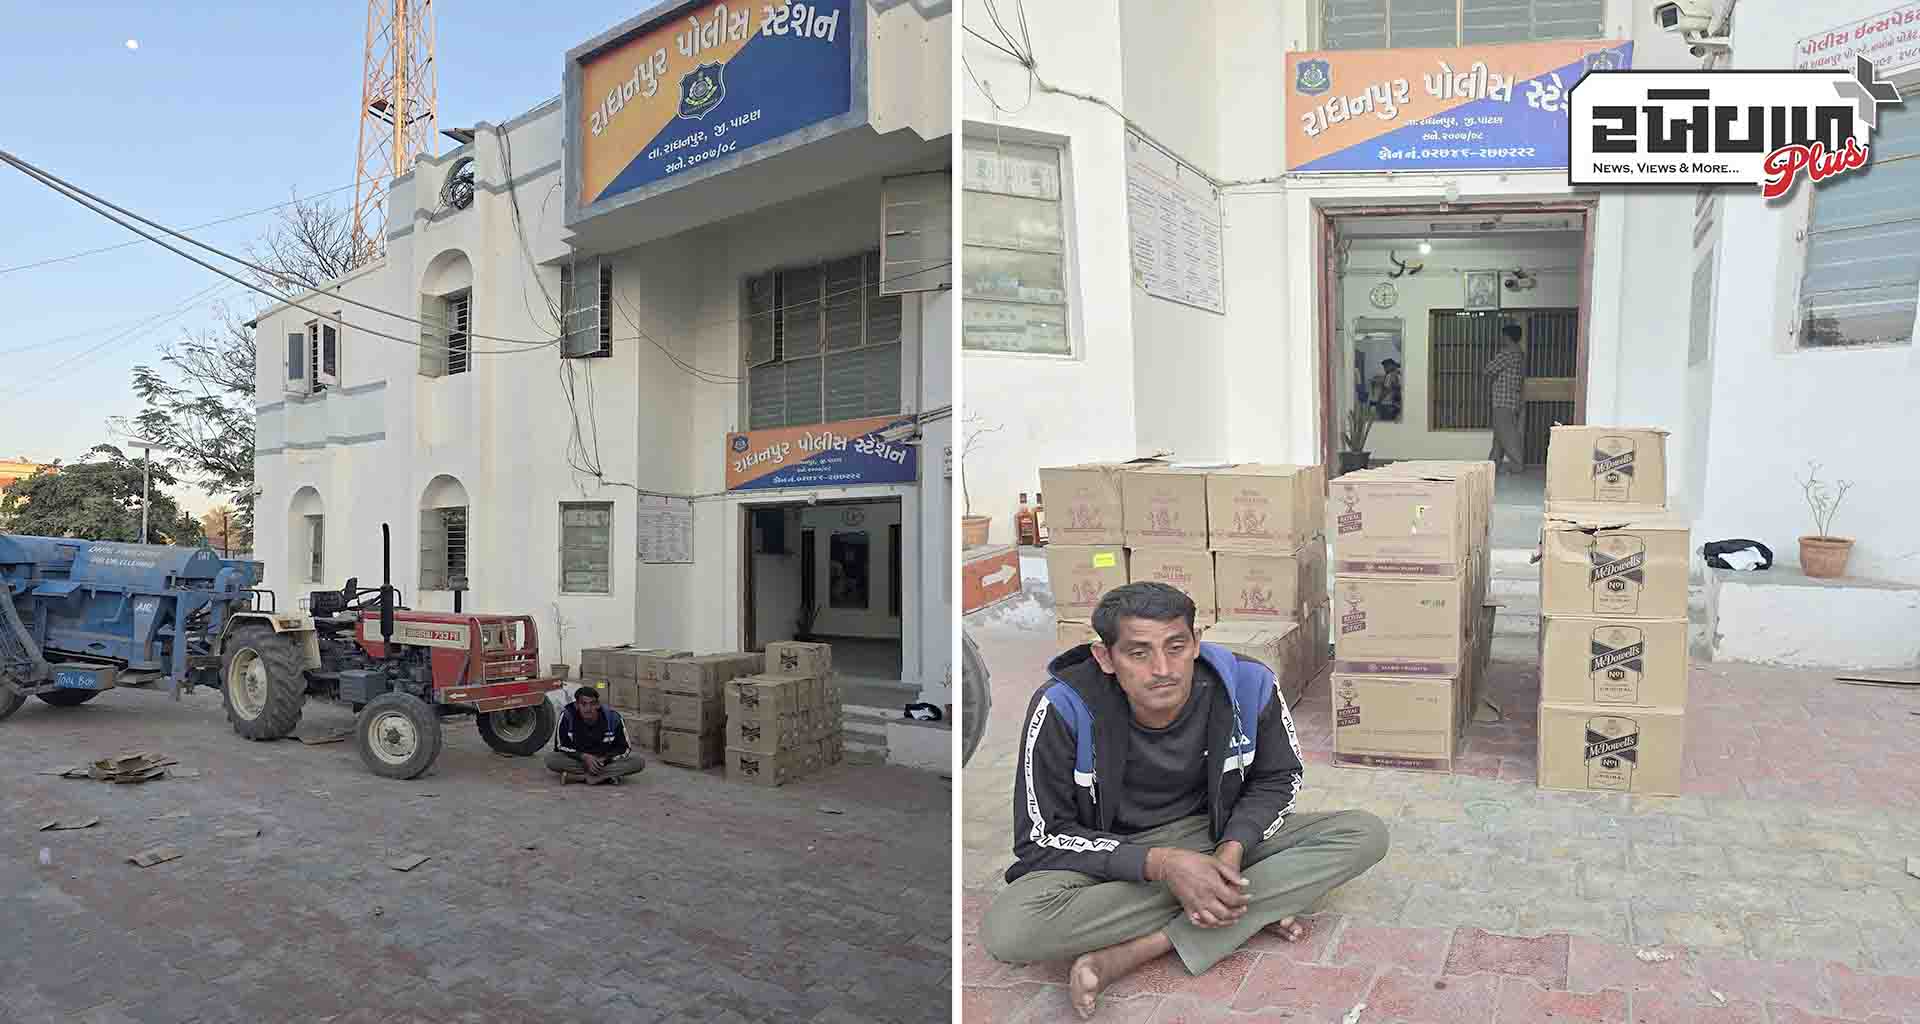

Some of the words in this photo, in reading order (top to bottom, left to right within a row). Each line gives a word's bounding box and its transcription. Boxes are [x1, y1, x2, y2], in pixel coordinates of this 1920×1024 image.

[678, 3, 750, 57] પોલીસ
[760, 0, 840, 42] સ્ટેશન
[1302, 78, 1410, 137] રાધનપુર
[1423, 60, 1515, 104] પોલીસ
[798, 431, 848, 452] પોલીસ
